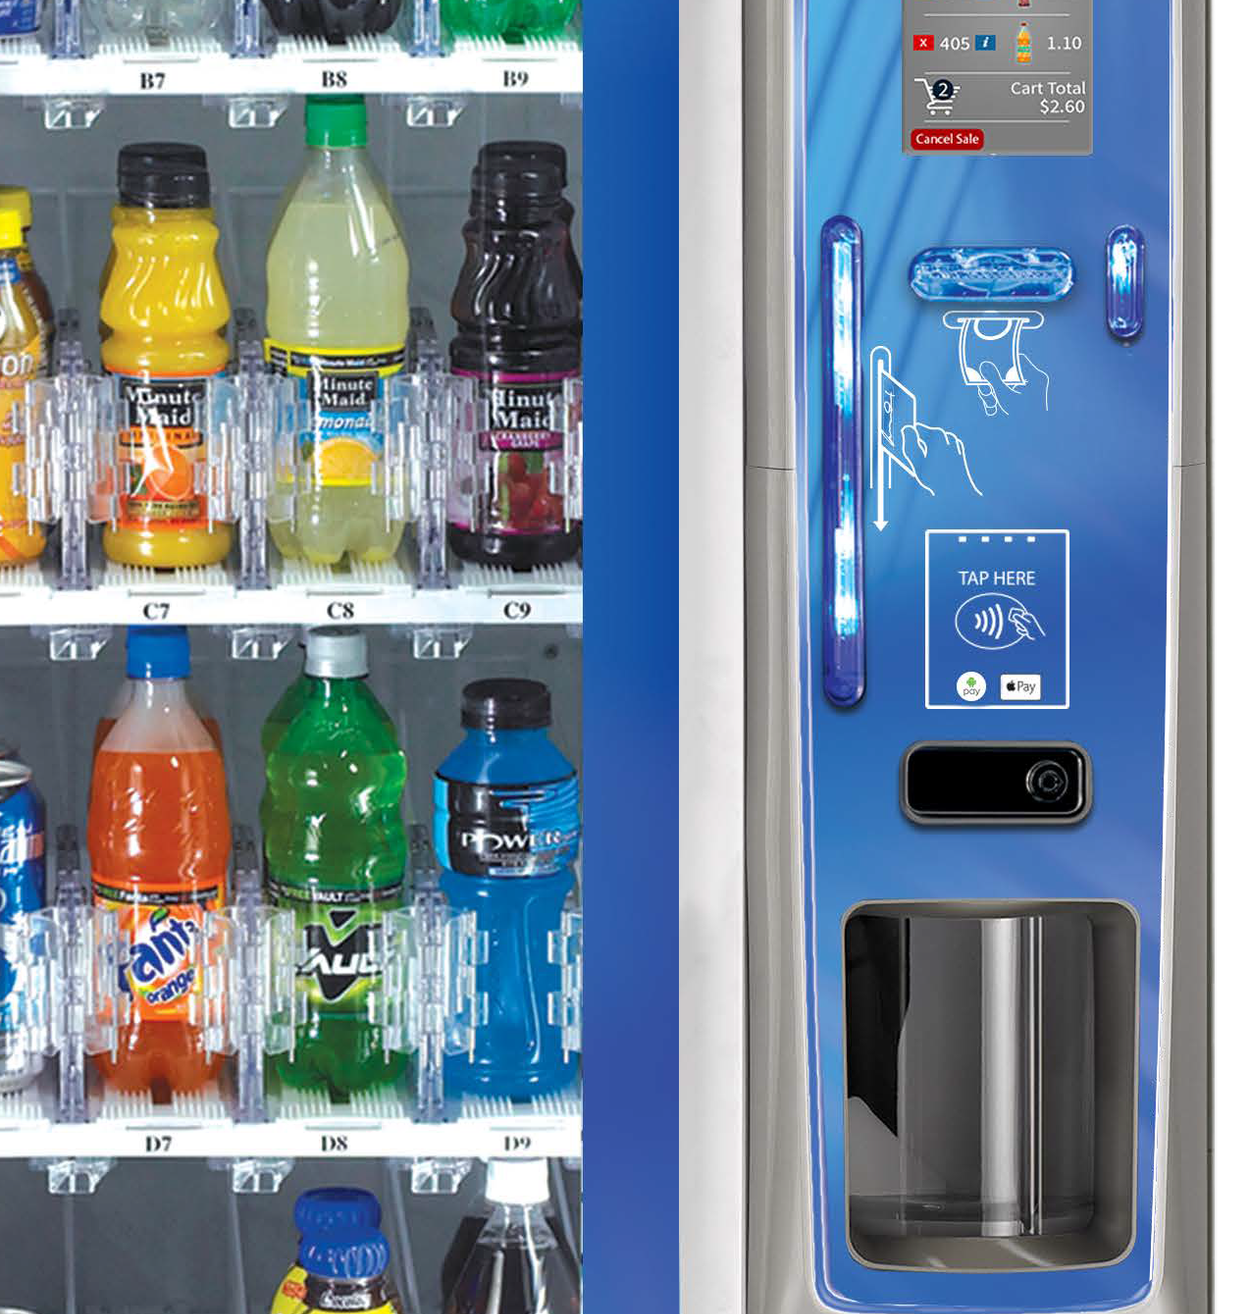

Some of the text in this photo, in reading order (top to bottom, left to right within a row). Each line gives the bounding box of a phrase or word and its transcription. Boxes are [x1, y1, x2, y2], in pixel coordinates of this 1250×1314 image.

[939, 37, 970, 51] 405
[1047, 36, 1082, 50] 1.10
[139, 72, 166, 90] B7
[321, 71, 348, 88] B8
[503, 70, 529, 87] B9
[937, 83, 948, 97] 2
[1010, 81, 1086, 95] Cart Total
[1039, 99, 1085, 115] $2.60
[915, 132, 979, 145] Cancel Sale
[320, 392, 367, 407] Maid
[958, 570, 1036, 586] TAP HERE
[143, 603, 170, 621] C7
[326, 602, 355, 620] C8
[503, 602, 531, 620] C9
[963, 687, 981, 697] pay
[1017, 680, 1036, 694] Pay
[145, 1135, 172, 1153] D7
[321, 1135, 348, 1153] D8
[504, 1135, 531, 1153] D9
